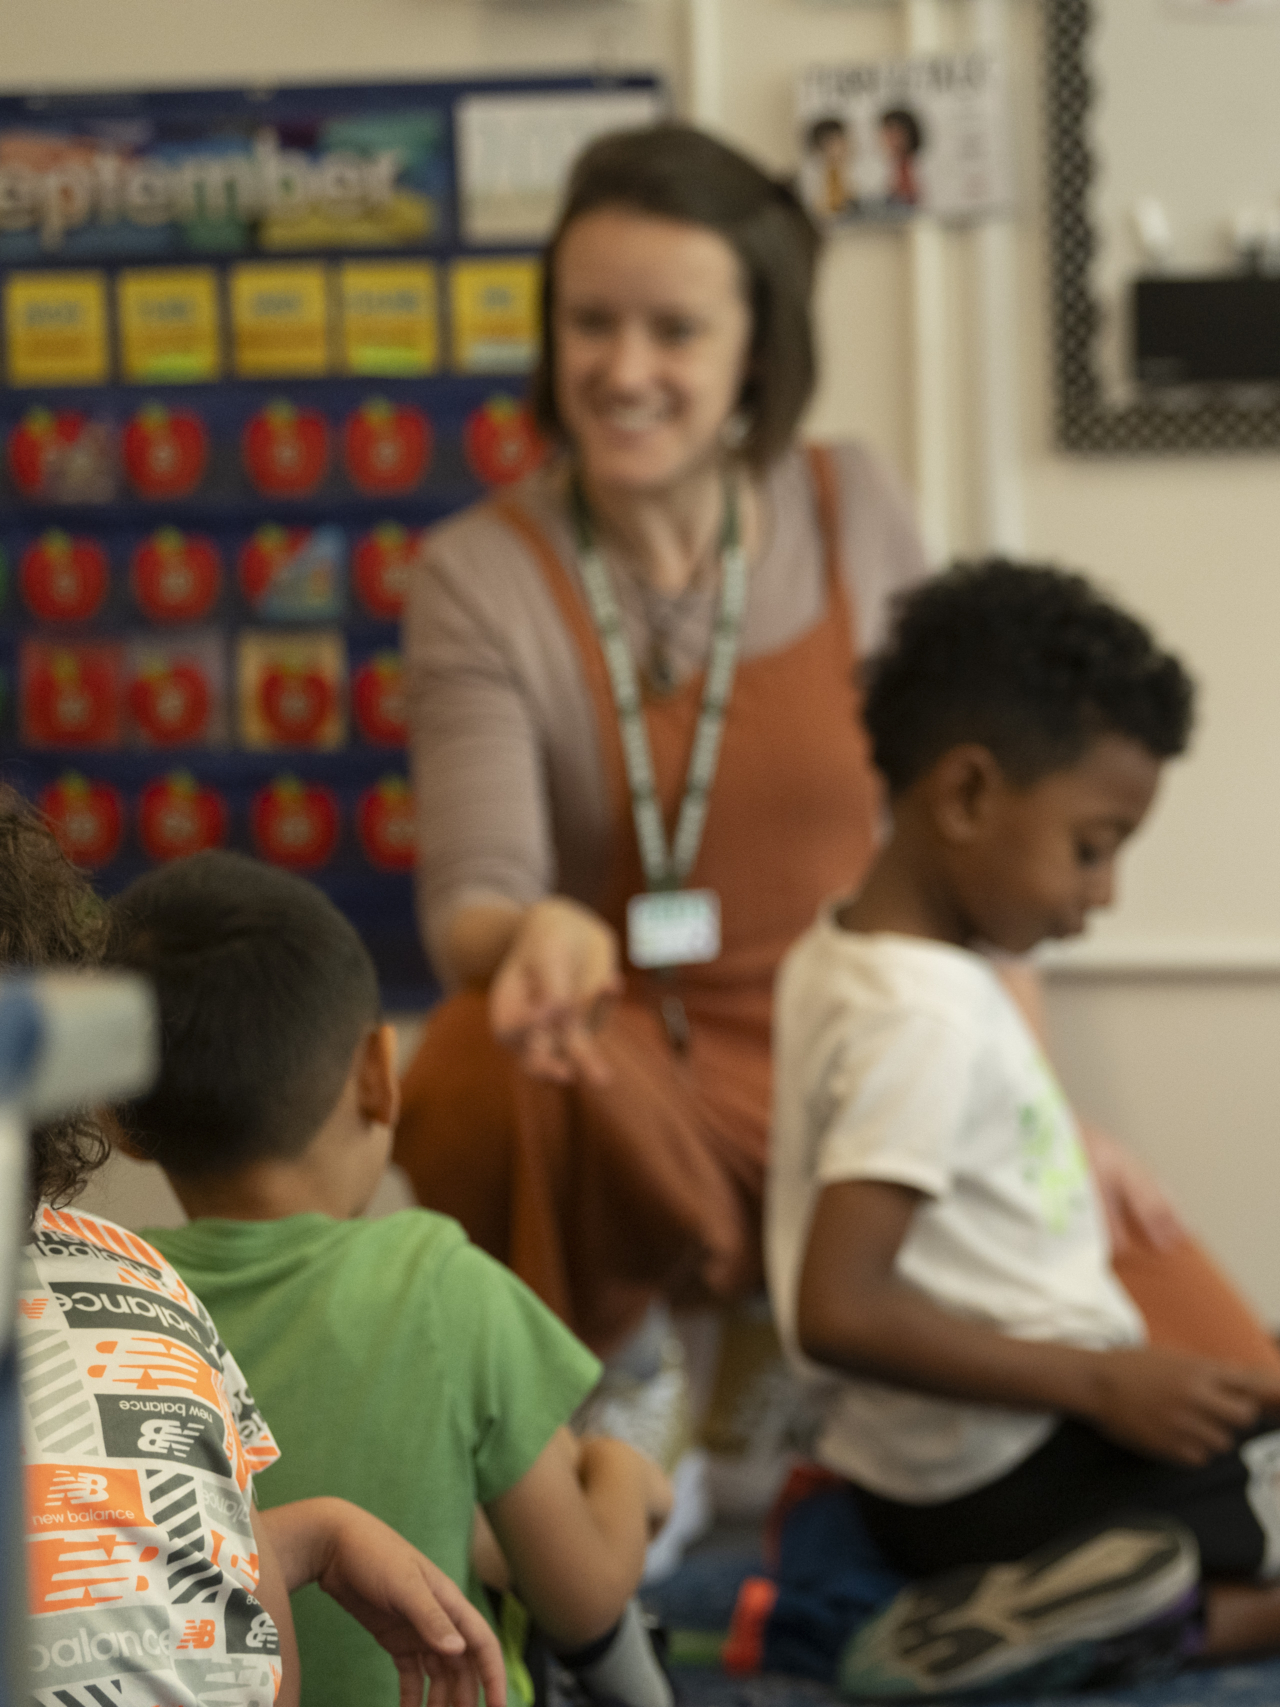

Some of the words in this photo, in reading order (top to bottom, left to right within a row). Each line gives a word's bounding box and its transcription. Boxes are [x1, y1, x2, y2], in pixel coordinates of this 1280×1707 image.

[119, 1400, 186, 1417] balance
[189, 1405, 213, 1423] new
[32, 1512, 65, 1526] new
[67, 1508, 135, 1524] balance
